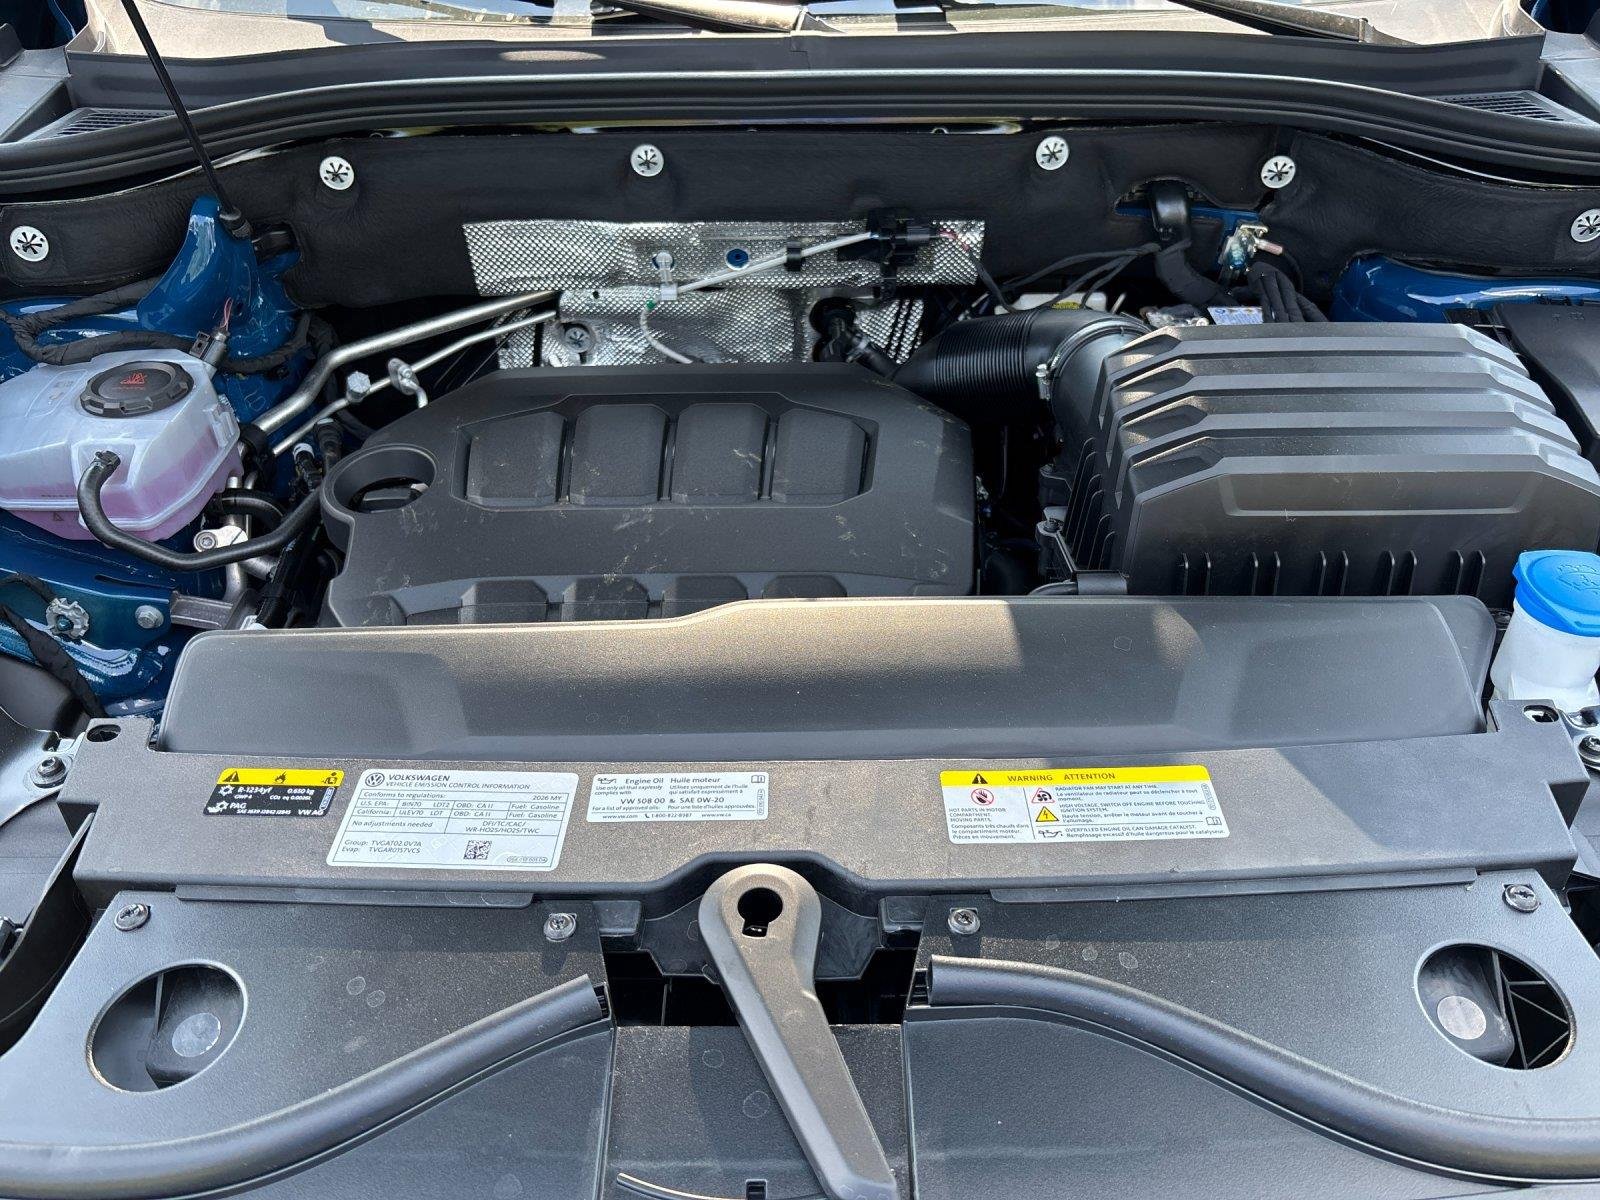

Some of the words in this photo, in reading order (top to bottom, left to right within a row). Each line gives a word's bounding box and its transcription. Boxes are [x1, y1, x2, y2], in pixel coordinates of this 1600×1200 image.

[388, 774, 451, 782] VOLKSWAGEN
[1063, 773, 1116, 781] ATTENTION
[625, 778, 652, 786] Engine
[237, 786, 273, 795] R-1234yf
[306, 788, 315, 796] kg
[405, 792, 447, 800] regulations:
[363, 820, 406, 829] adjustments
[344, 839, 369, 848] Group:
